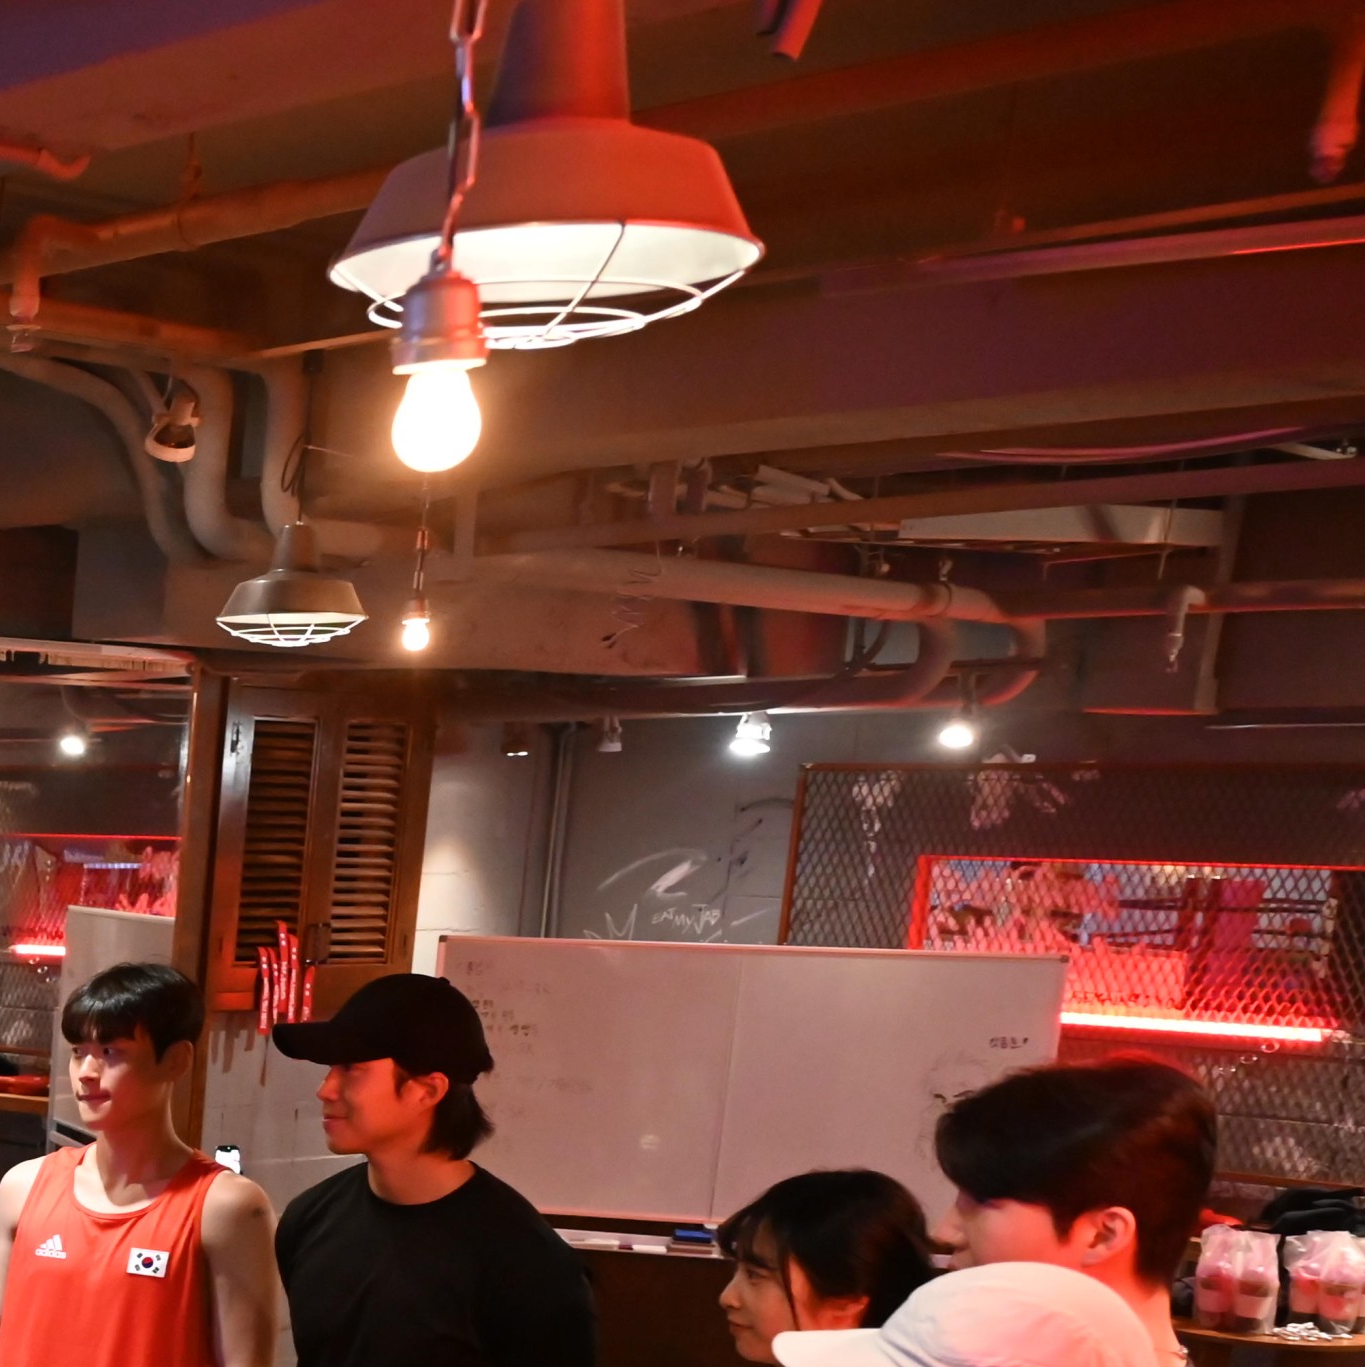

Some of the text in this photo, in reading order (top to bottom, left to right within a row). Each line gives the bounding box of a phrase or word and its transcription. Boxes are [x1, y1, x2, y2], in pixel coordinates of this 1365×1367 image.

[652, 904, 721, 935] EAT MY JAB
